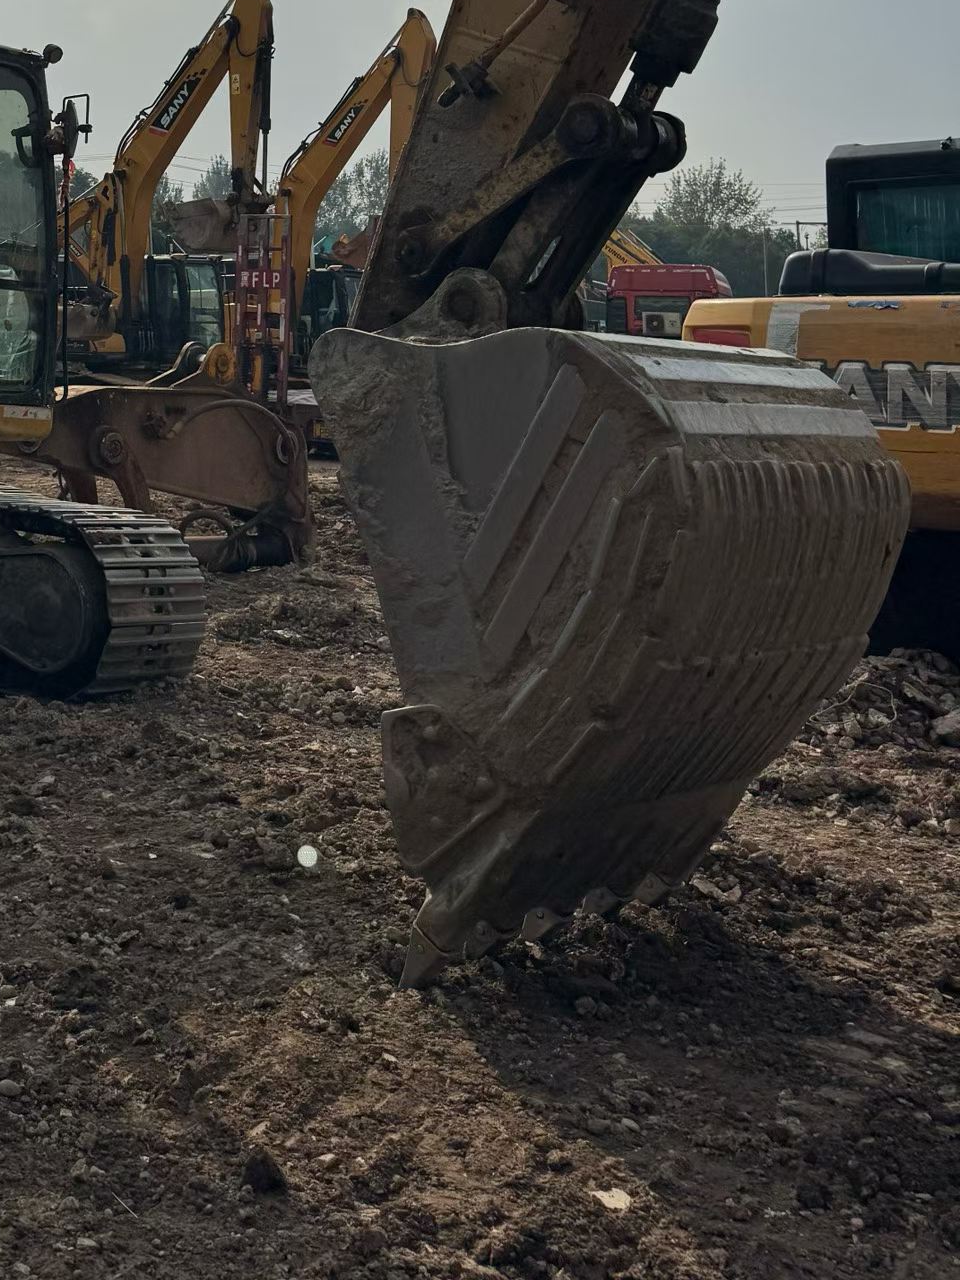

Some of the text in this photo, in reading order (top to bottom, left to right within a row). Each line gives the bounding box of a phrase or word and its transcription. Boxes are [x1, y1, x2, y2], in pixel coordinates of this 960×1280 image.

[160, 83, 189, 128] SANY
[334, 108, 356, 140] SANY
[604, 244, 628, 264] YUNDAI
[833, 361, 960, 428] AN
